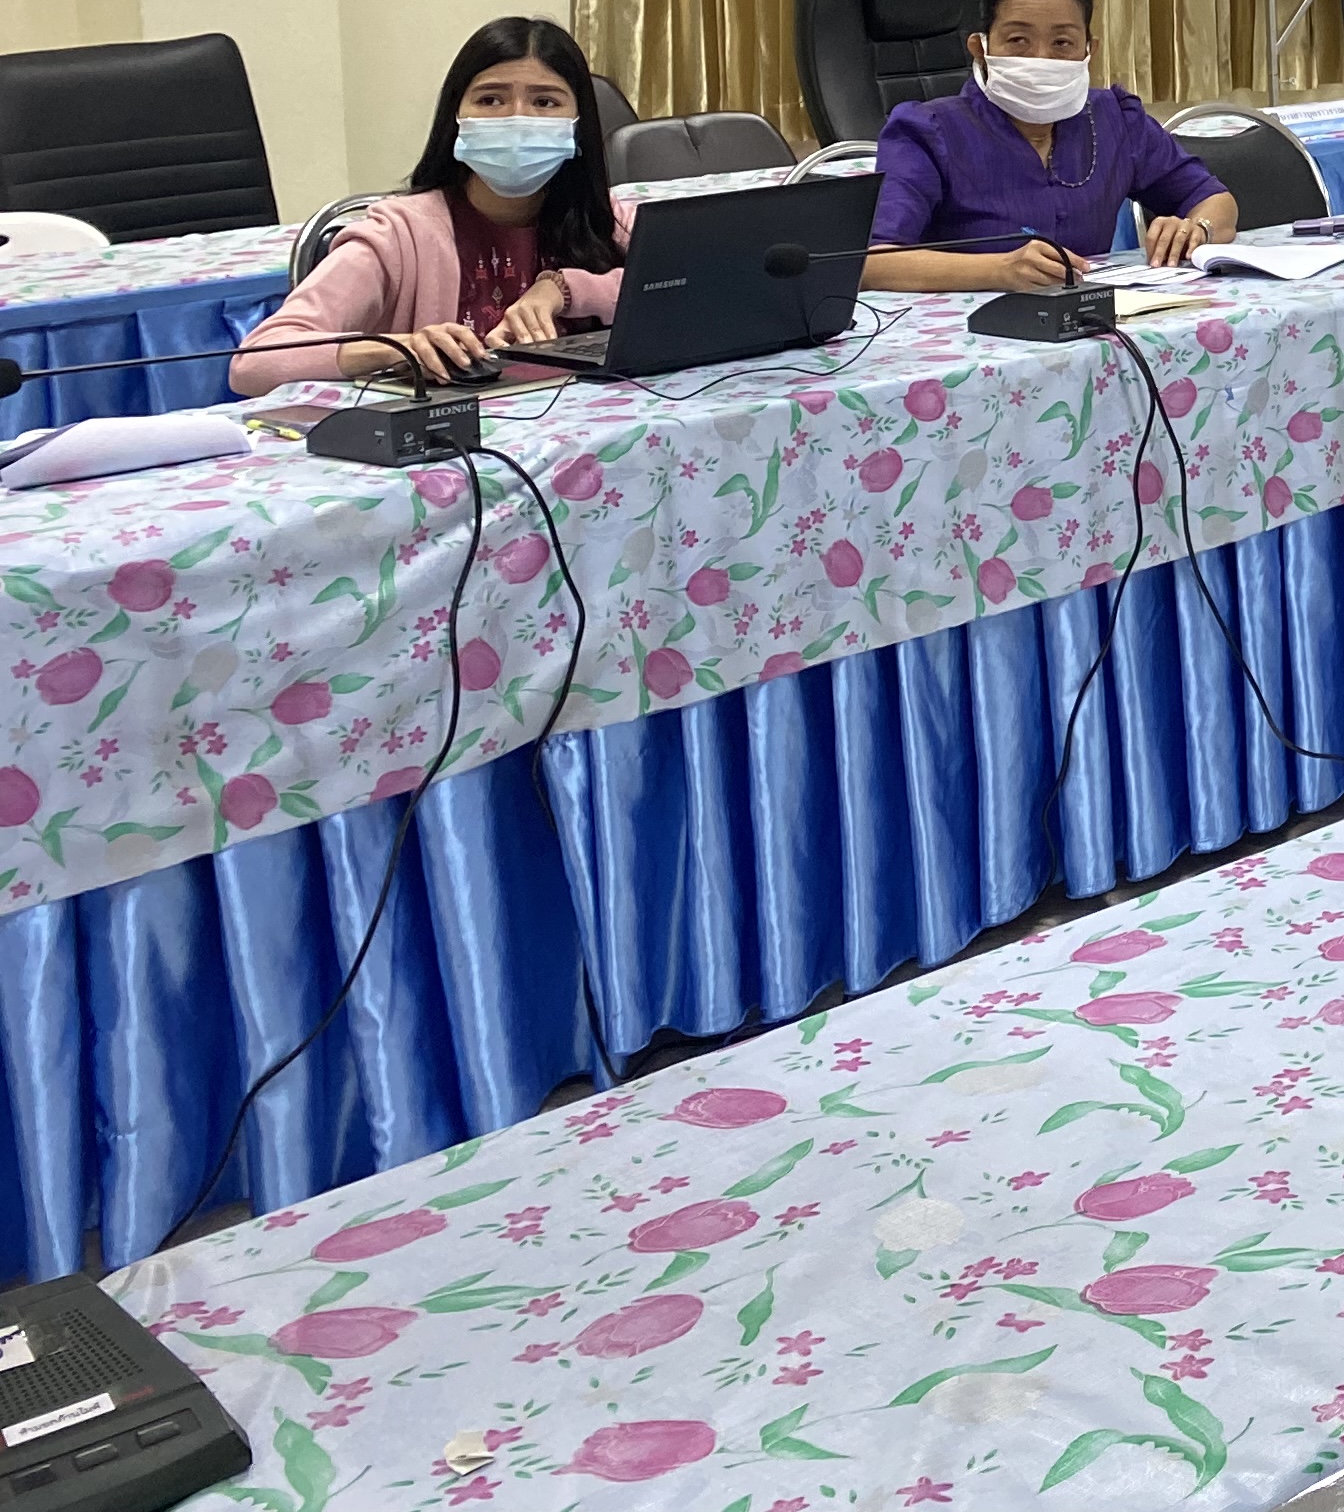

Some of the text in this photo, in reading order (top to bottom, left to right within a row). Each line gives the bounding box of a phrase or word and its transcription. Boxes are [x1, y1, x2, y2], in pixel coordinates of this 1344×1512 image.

[643, 277, 687, 292] SAMSUNG
[1080, 289, 1114, 303] HONIC
[428, 401, 477, 419] HONIC
